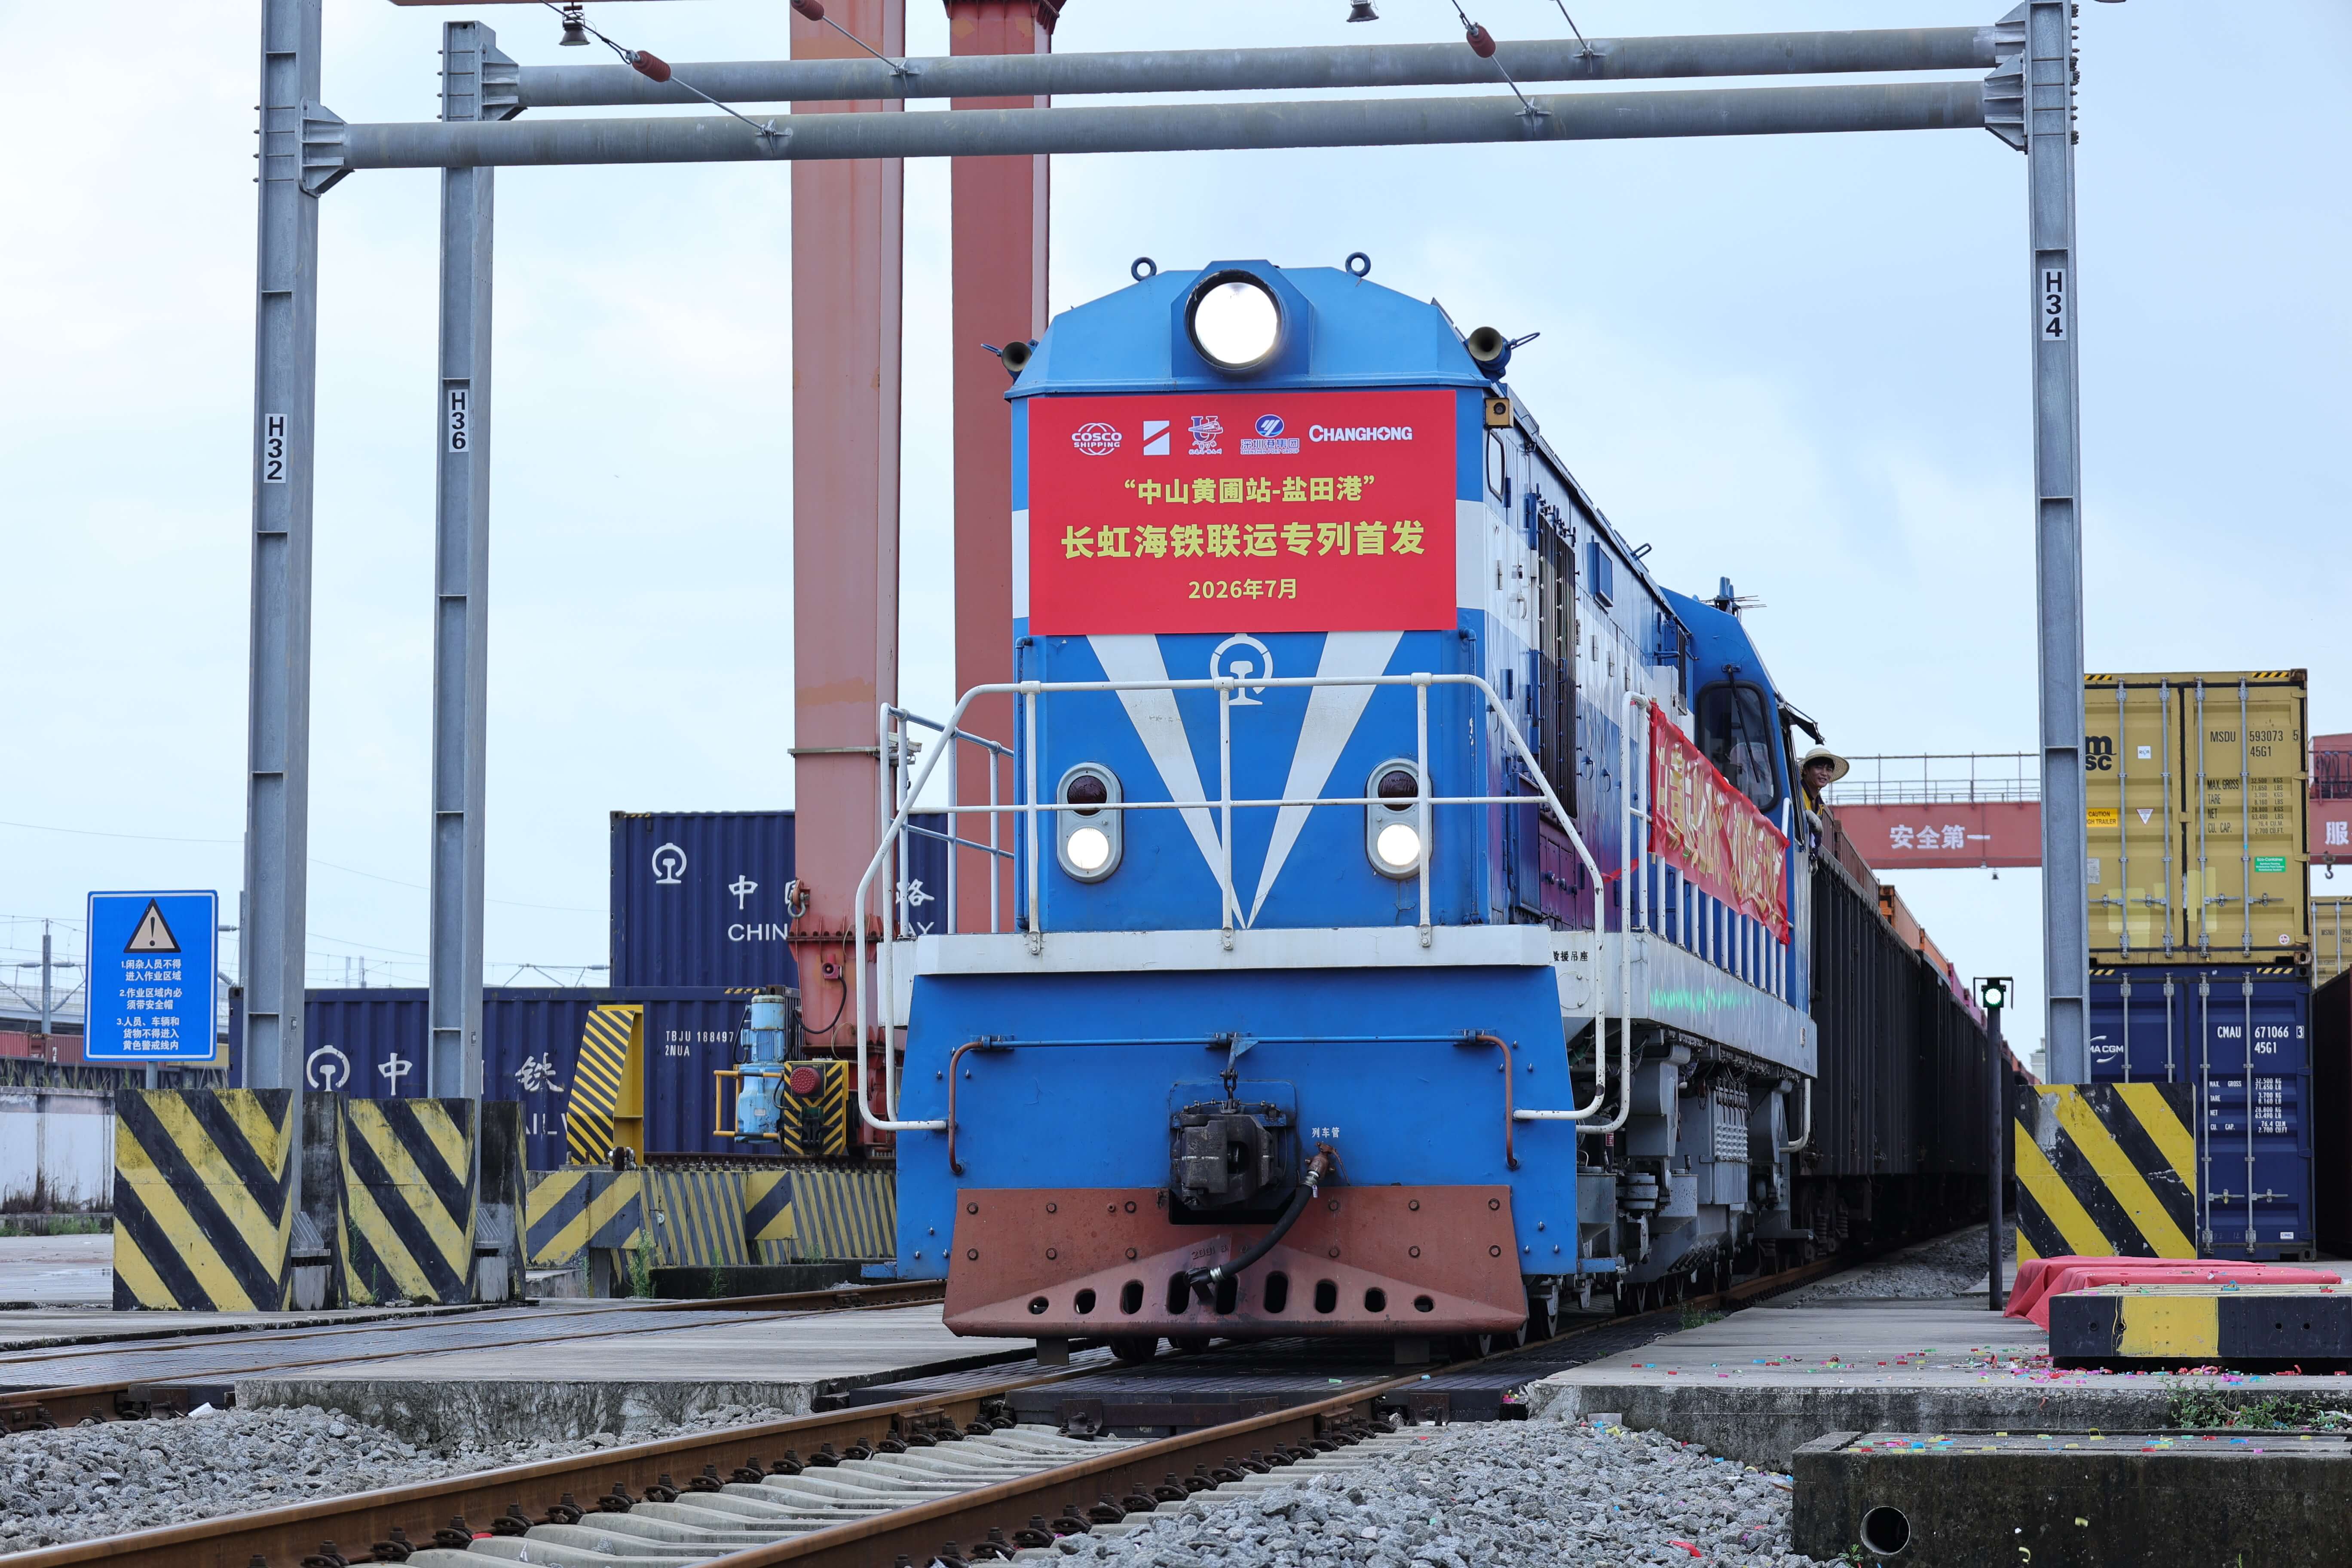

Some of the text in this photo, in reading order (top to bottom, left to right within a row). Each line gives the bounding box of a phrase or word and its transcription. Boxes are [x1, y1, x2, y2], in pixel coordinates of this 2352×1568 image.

[2046, 271, 2063, 337] H34
[451, 392, 466, 450] H36
[1071, 432, 1122, 441] COSCO
[1309, 425, 1412, 442] CHANGHONG
[267, 416, 284, 480] H32
[1240, 438, 1300, 449] 深圳港集团
[1124, 475, 1375, 505] “中山黄圃站-盐田港”
[1061, 520, 1425, 559] 长虹海铁联运专列首发
[1188, 578, 1298, 600] 2026年7月
[2210, 731, 2236, 742] MSDU
[2249, 730, 2283, 741] 593073
[2250, 746, 2272, 757] 45G1
[2222, 779, 2239, 790] GROSS
[2208, 794, 2221, 804] TARE
[2208, 808, 2217, 819] NET
[1890, 824, 1991, 850] 安全第一
[2324, 821, 2352, 846] 服
[728, 924, 788, 942] CHIN
[121, 959, 181, 969] 1.闲杂人员不得
[125, 970, 181, 981] 进入作业区域
[119, 987, 182, 998] 2.作业区域内必
[126, 999, 173, 1010] 须带安全帽
[123, 1028, 179, 1038] 货物不得进入
[666, 1030, 734, 1042] TBJU 188497
[2217, 1026, 2303, 1038] CMAU 671066 3
[123, 1040, 179, 1050] 黄色警戒线内
[2254, 1041, 2276, 1054] 45G1
[1311, 1127, 1340, 1138] 列车管
